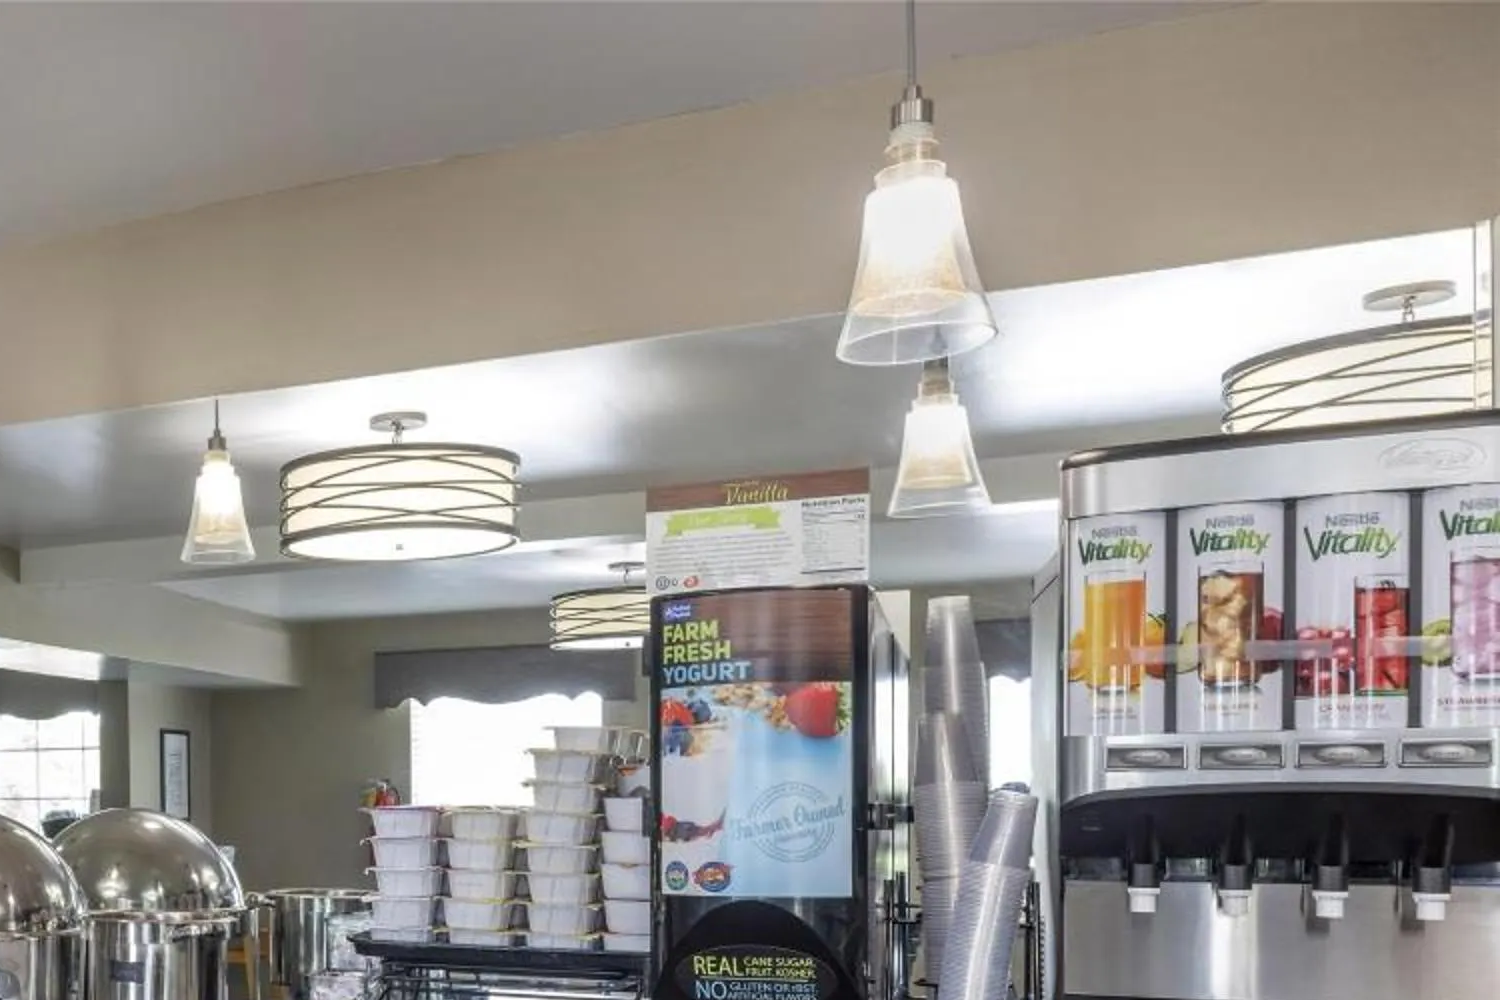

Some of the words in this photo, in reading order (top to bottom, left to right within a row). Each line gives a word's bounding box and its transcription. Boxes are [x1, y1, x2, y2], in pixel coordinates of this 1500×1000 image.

[722, 479, 789, 505] Vanilla
[1439, 508, 1500, 541] Vital
[1077, 536, 1153, 566] Vitality
[1189, 527, 1270, 557] Vitality
[1303, 526, 1401, 562] Vitality
[663, 620, 719, 644] FARM
[663, 640, 732, 665] FRESH
[662, 660, 752, 684] YOGURT
[693, 955, 744, 977] REAL
[743, 956, 773, 967] CANE
[695, 980, 727, 1000] NO
